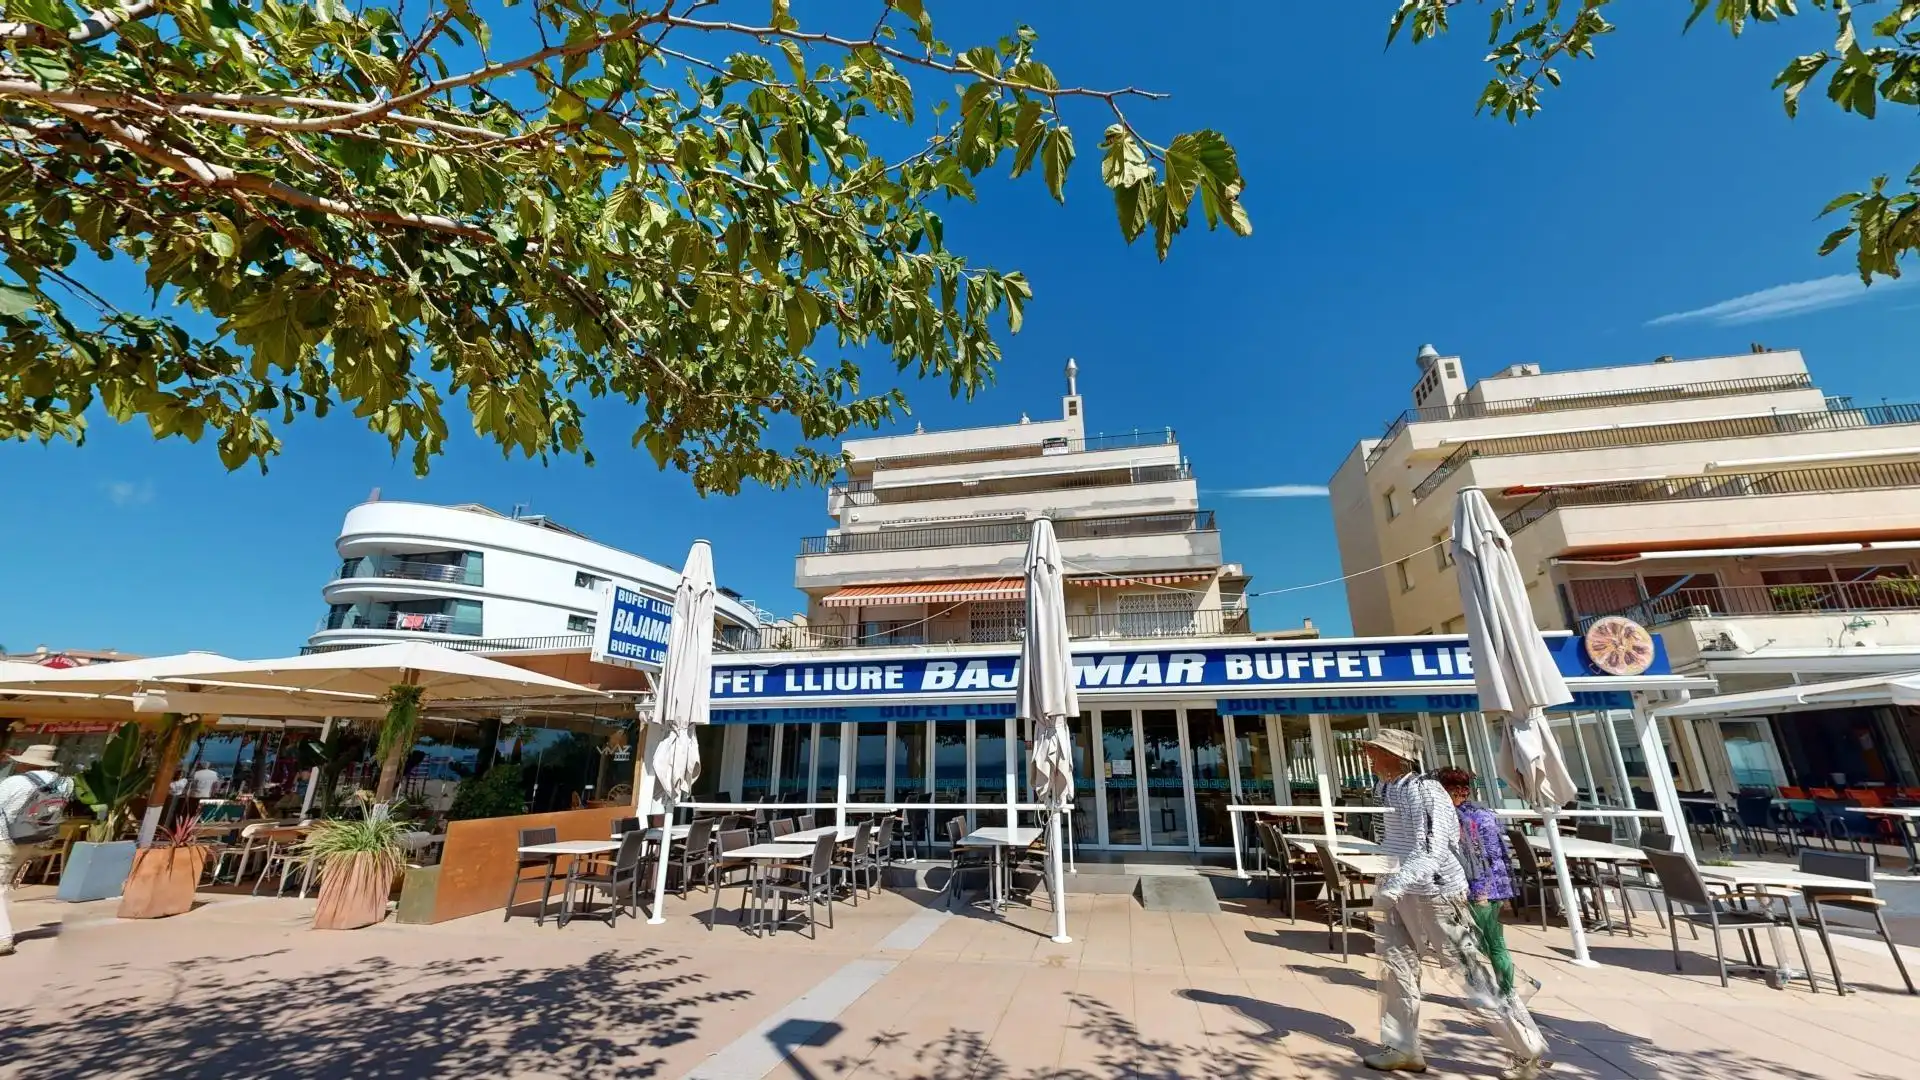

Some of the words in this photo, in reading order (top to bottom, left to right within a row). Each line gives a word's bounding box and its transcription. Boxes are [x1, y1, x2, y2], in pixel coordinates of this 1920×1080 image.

[618, 589, 648, 609] BUFET
[651, 600, 673, 618] LLIU
[613, 608, 672, 645] BAJAMA
[610, 638, 647, 659] BUFFET
[650, 648, 667, 663] LIB
[714, 670, 768, 694] FET
[785, 666, 904, 692] LLIURE
[921, 653, 1207, 690] BAJMAR
[1225, 650, 1385, 681] BUFFET
[710, 708, 768, 722] UFFET
[963, 703, 1016, 716] LLIU
